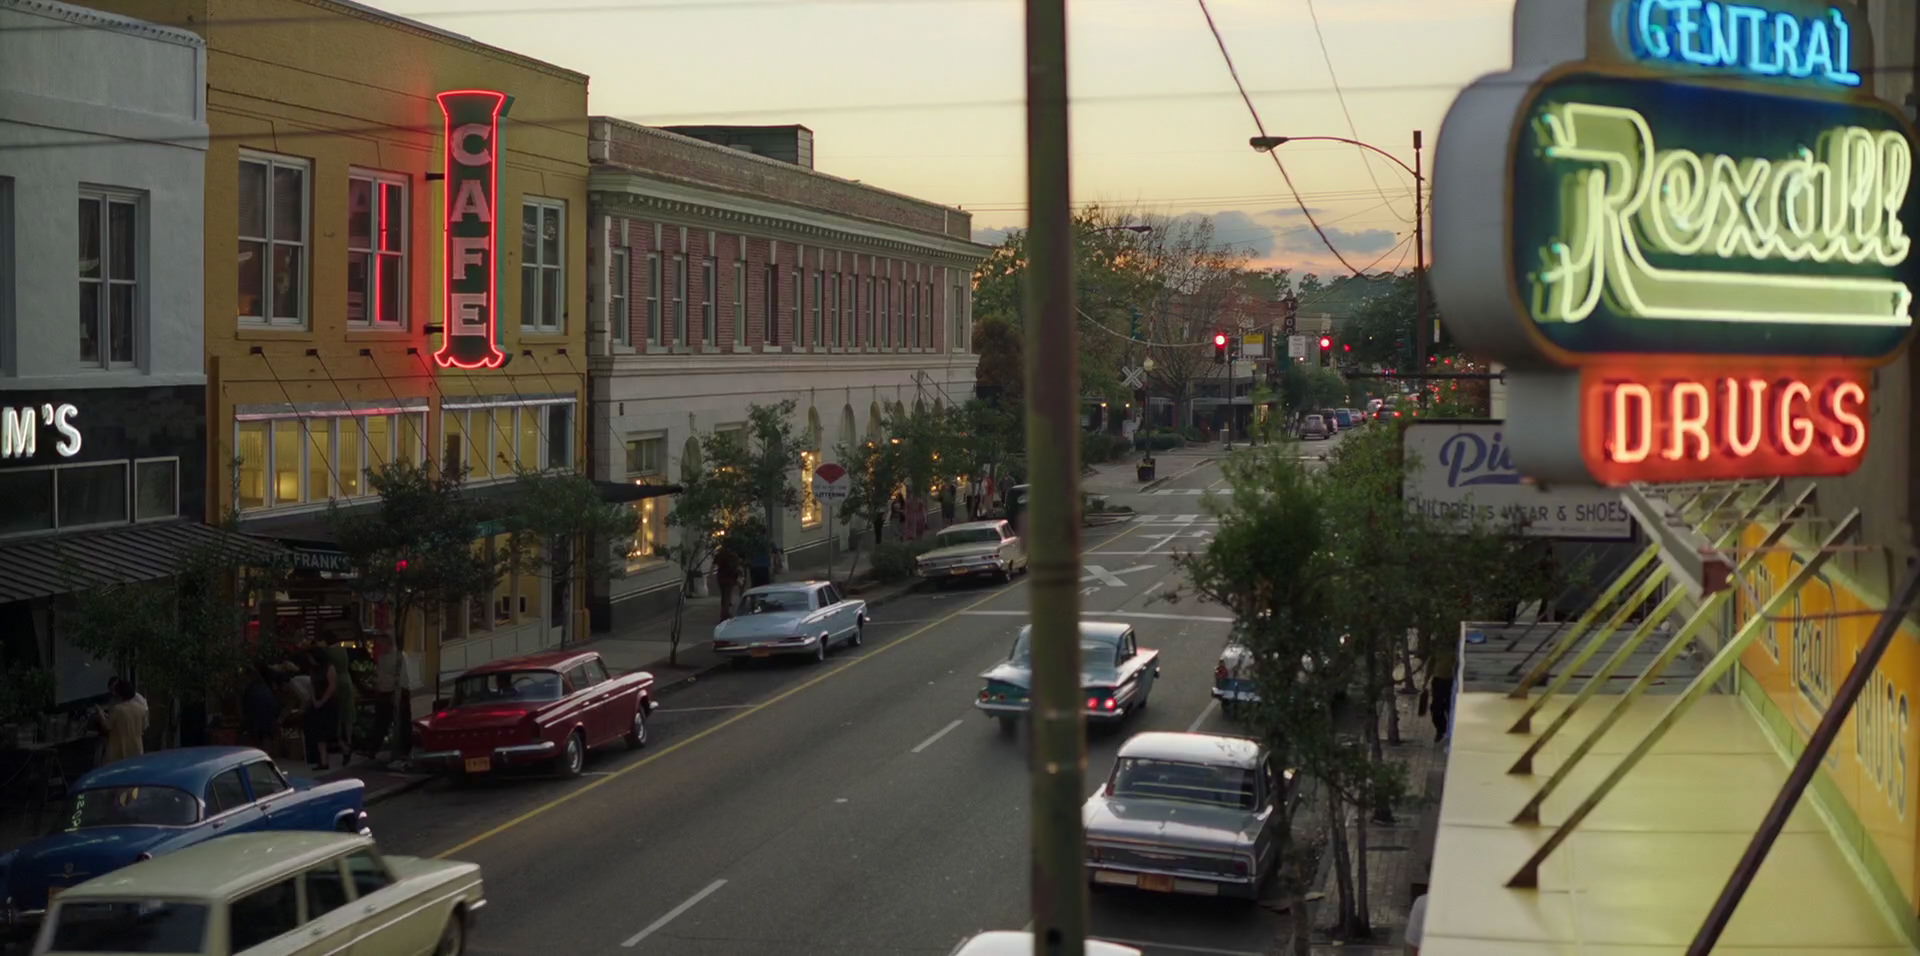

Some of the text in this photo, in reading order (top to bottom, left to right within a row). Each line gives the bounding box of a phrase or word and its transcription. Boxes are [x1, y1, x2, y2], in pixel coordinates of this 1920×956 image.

[1634, 0, 1860, 85] CENTRAL
[450, 123, 492, 337] CAFE
[1531, 101, 1912, 326] Rexall
[1, 403, 82, 458] M'S
[1609, 378, 1866, 463] DRUGS
[1557, 505, 1568, 521] &
[1575, 501, 1629, 523] SHOES
